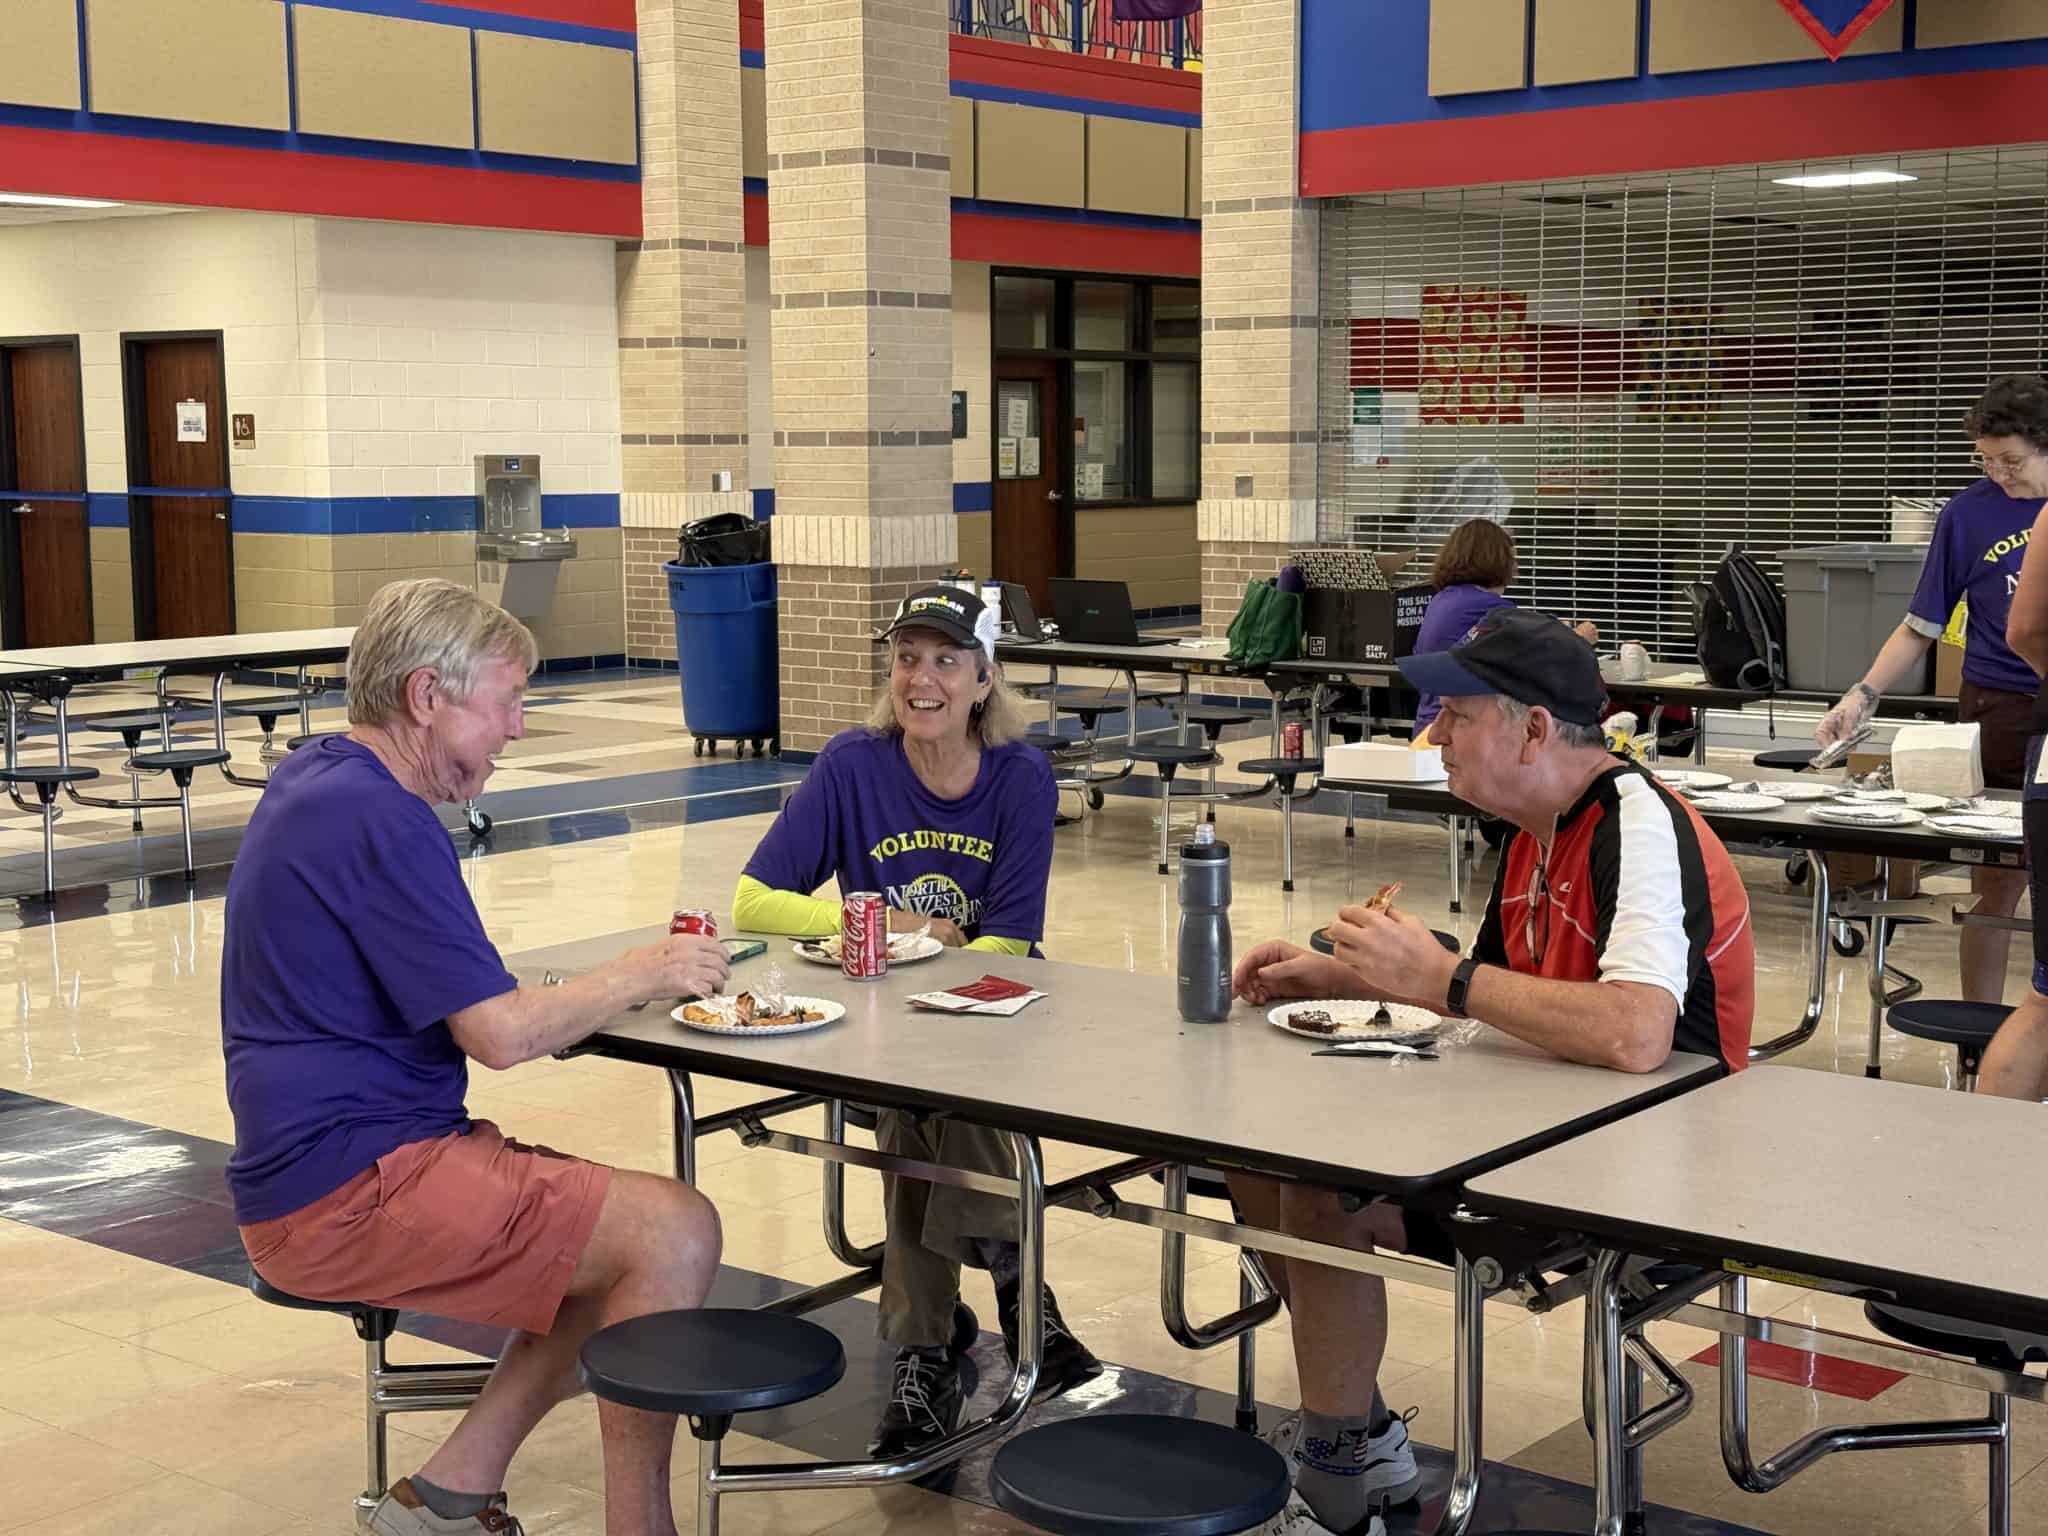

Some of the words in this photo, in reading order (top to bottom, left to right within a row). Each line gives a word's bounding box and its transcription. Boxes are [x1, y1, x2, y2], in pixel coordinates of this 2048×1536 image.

[1398, 597, 1413, 607] THIS
[1415, 595, 1432, 605] SALT
[1397, 608, 1404, 616] IS
[1406, 606, 1416, 616] ON
[1418, 606, 1423, 615] A
[1366, 644, 1383, 652] STAY
[1366, 651, 1388, 659] SALTY
[869, 830, 993, 863] VOLUNTEE
